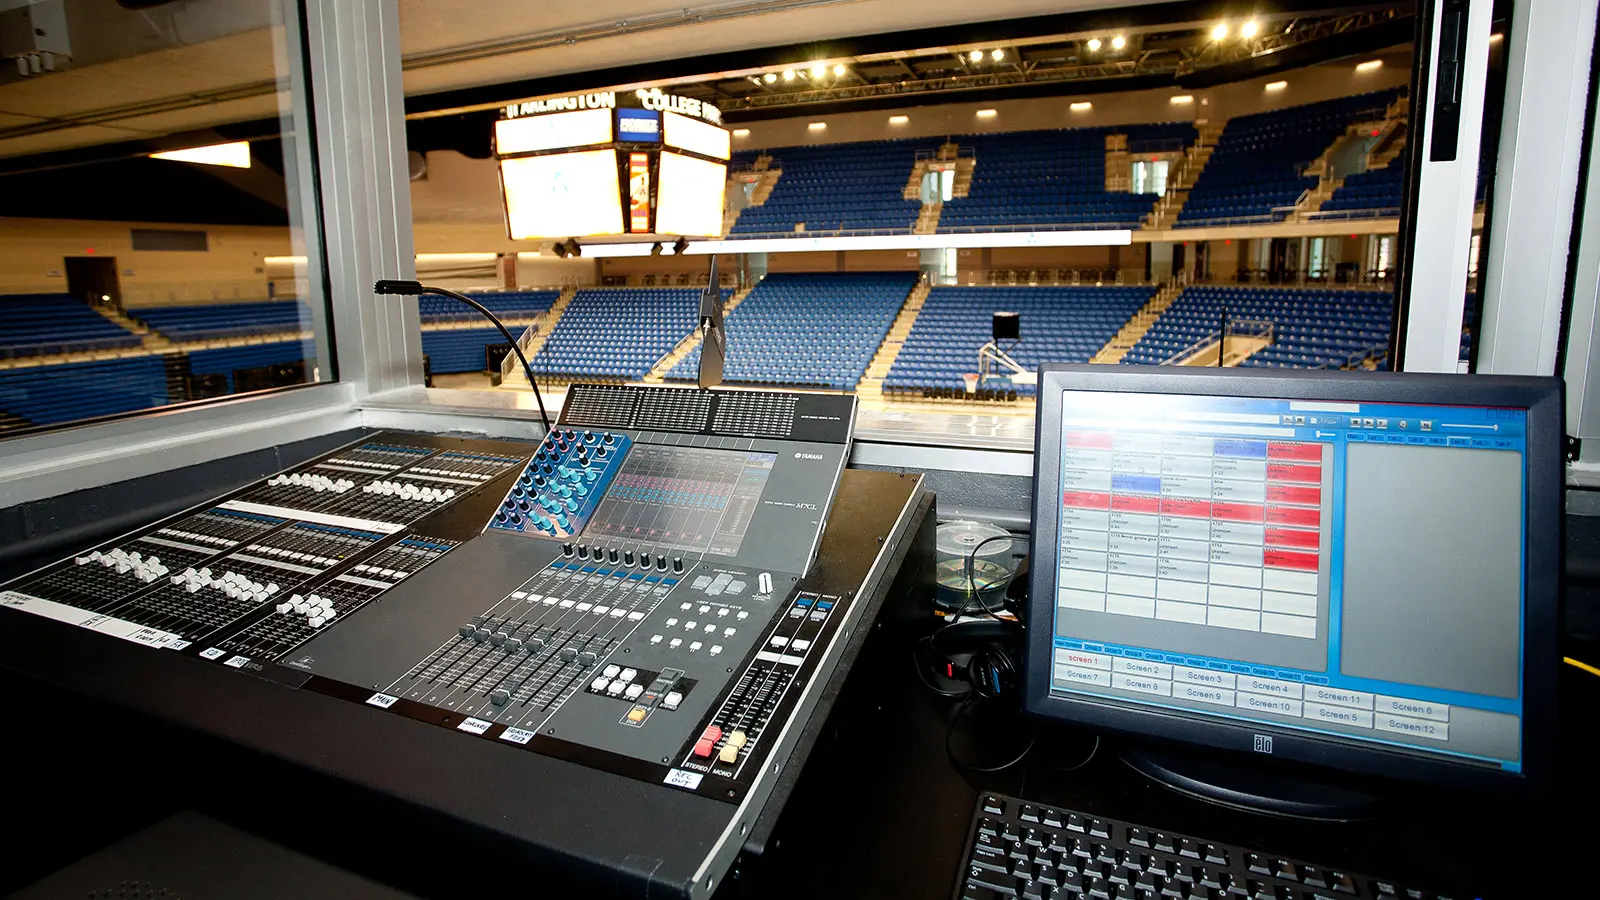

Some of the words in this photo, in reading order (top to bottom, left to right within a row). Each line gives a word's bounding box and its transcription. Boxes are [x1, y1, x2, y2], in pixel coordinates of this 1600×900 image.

[1068, 655, 1093, 664] screen
[1126, 662, 1152, 673] Screen
[1153, 666, 1160, 674] 2
[1066, 669, 1092, 680] Screen
[1187, 671, 1215, 682] Screen
[1125, 678, 1151, 690] Screen
[1152, 683, 1158, 691] 8
[1251, 681, 1281, 693] Screen
[1186, 688, 1214, 699] Screen
[1317, 691, 1349, 703] Screen
[1350, 696, 1361, 704] 11
[1249, 698, 1279, 710] Screen
[1280, 703, 1290, 711] 10
[1391, 702, 1424, 714] Screen
[1425, 707, 1433, 715] 6
[1319, 709, 1350, 721] Screen
[1351, 714, 1358, 722] 5
[1388, 719, 1420, 732] Screen
[1422, 725, 1435, 734] 12
[674, 771, 693, 780] REC
[684, 763, 709, 772] STEREO
[712, 768, 732, 778] MONO
[671, 778, 692, 788] OUT
[1014, 841, 1021, 849] Q
[1052, 886, 1059, 894] X
[1145, 890, 1152, 898] H
[1218, 889, 1226, 897] O
